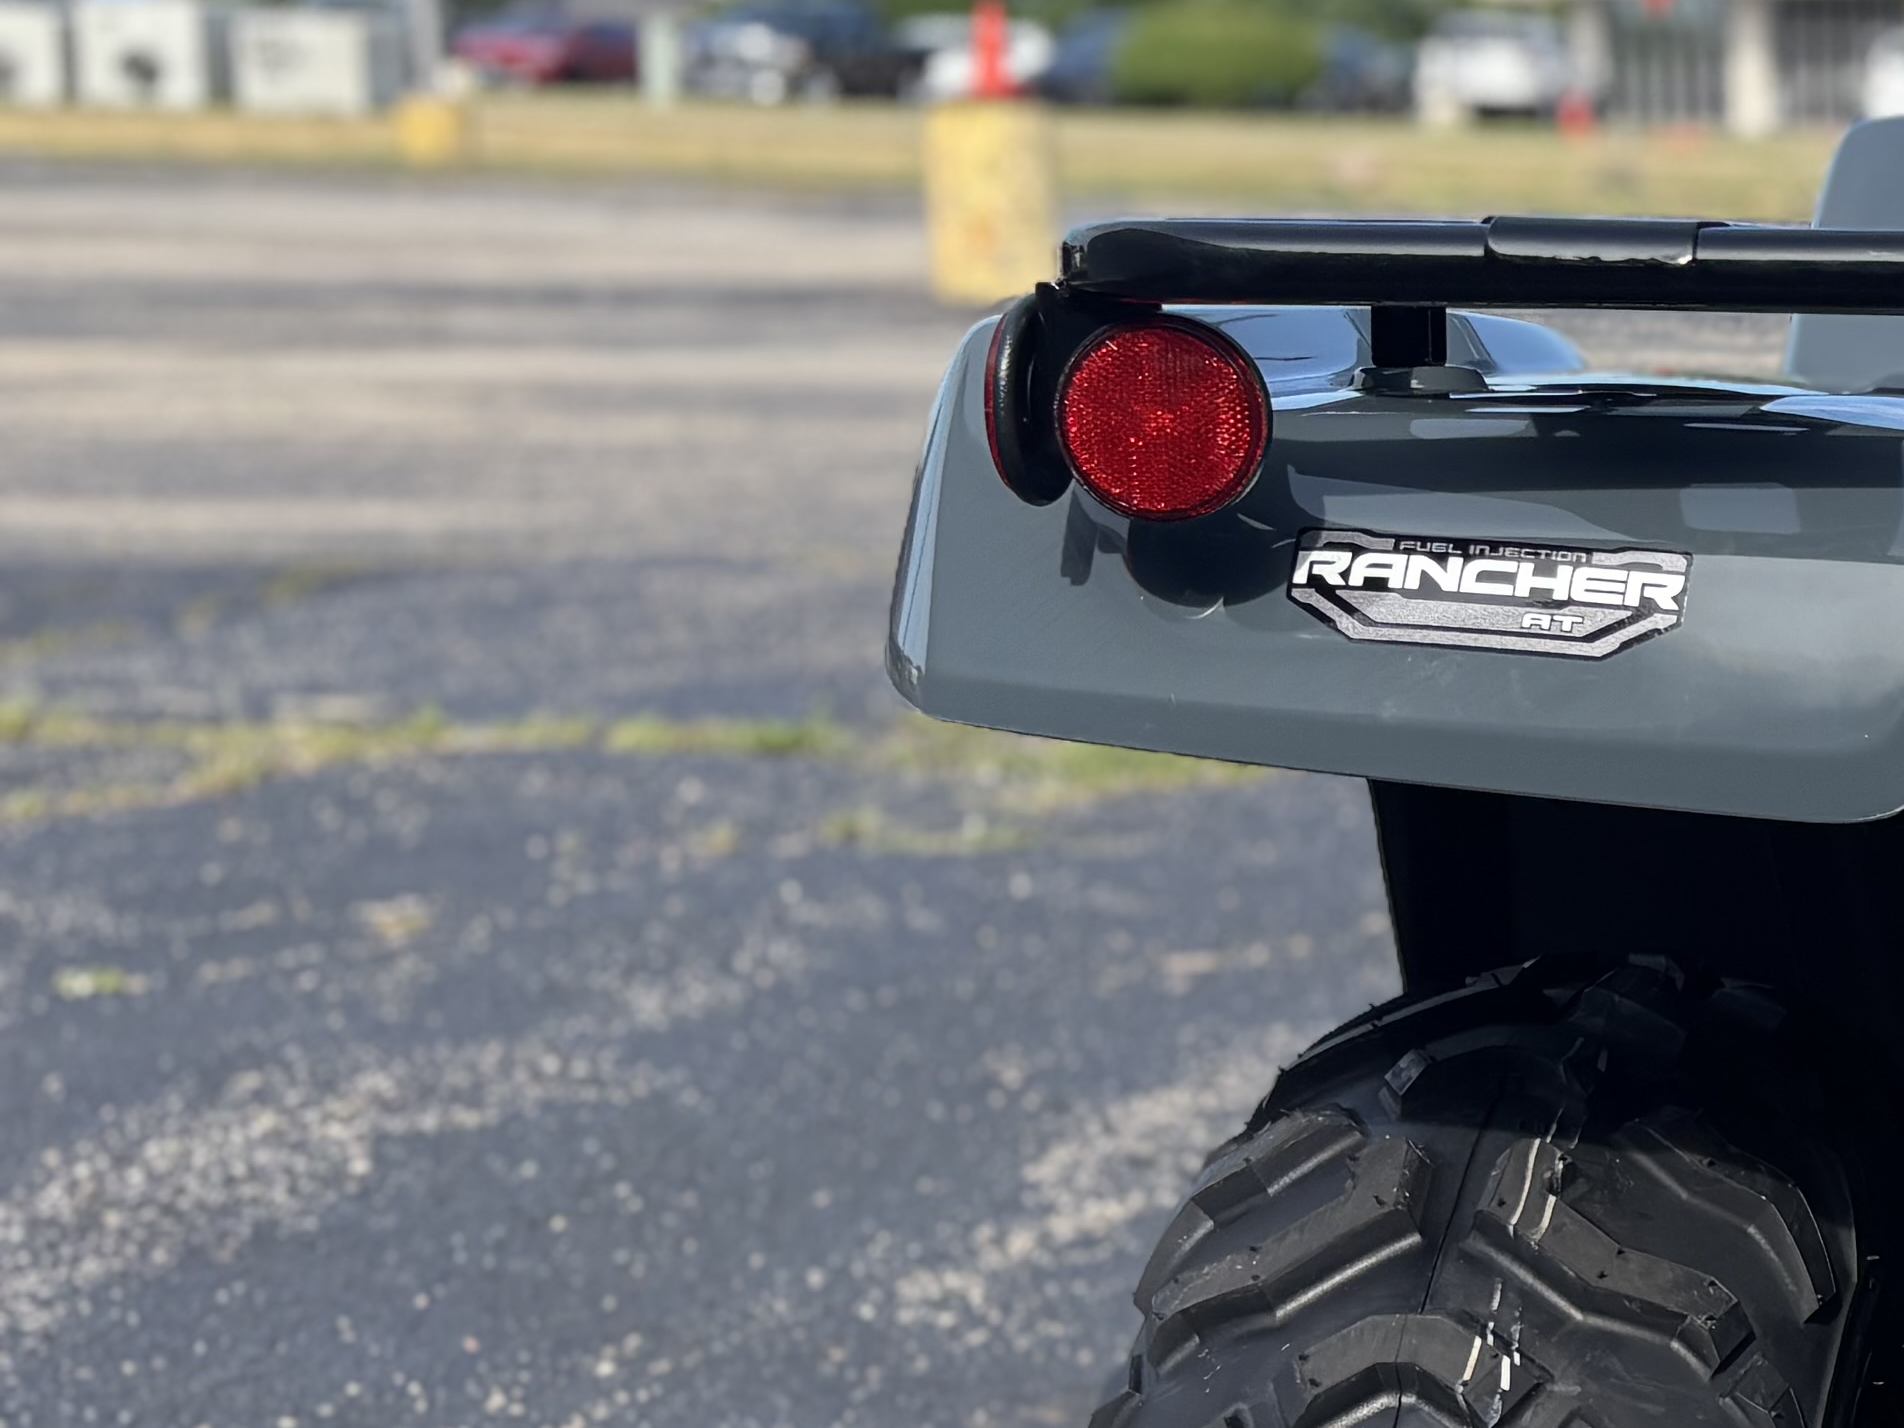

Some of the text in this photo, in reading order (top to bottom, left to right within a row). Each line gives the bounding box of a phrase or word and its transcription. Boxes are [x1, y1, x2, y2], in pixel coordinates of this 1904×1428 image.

[1399, 540, 1588, 563] FUEL INJECTION
[1292, 550, 1686, 611] RANCHER
[1520, 613, 1584, 632] AT
